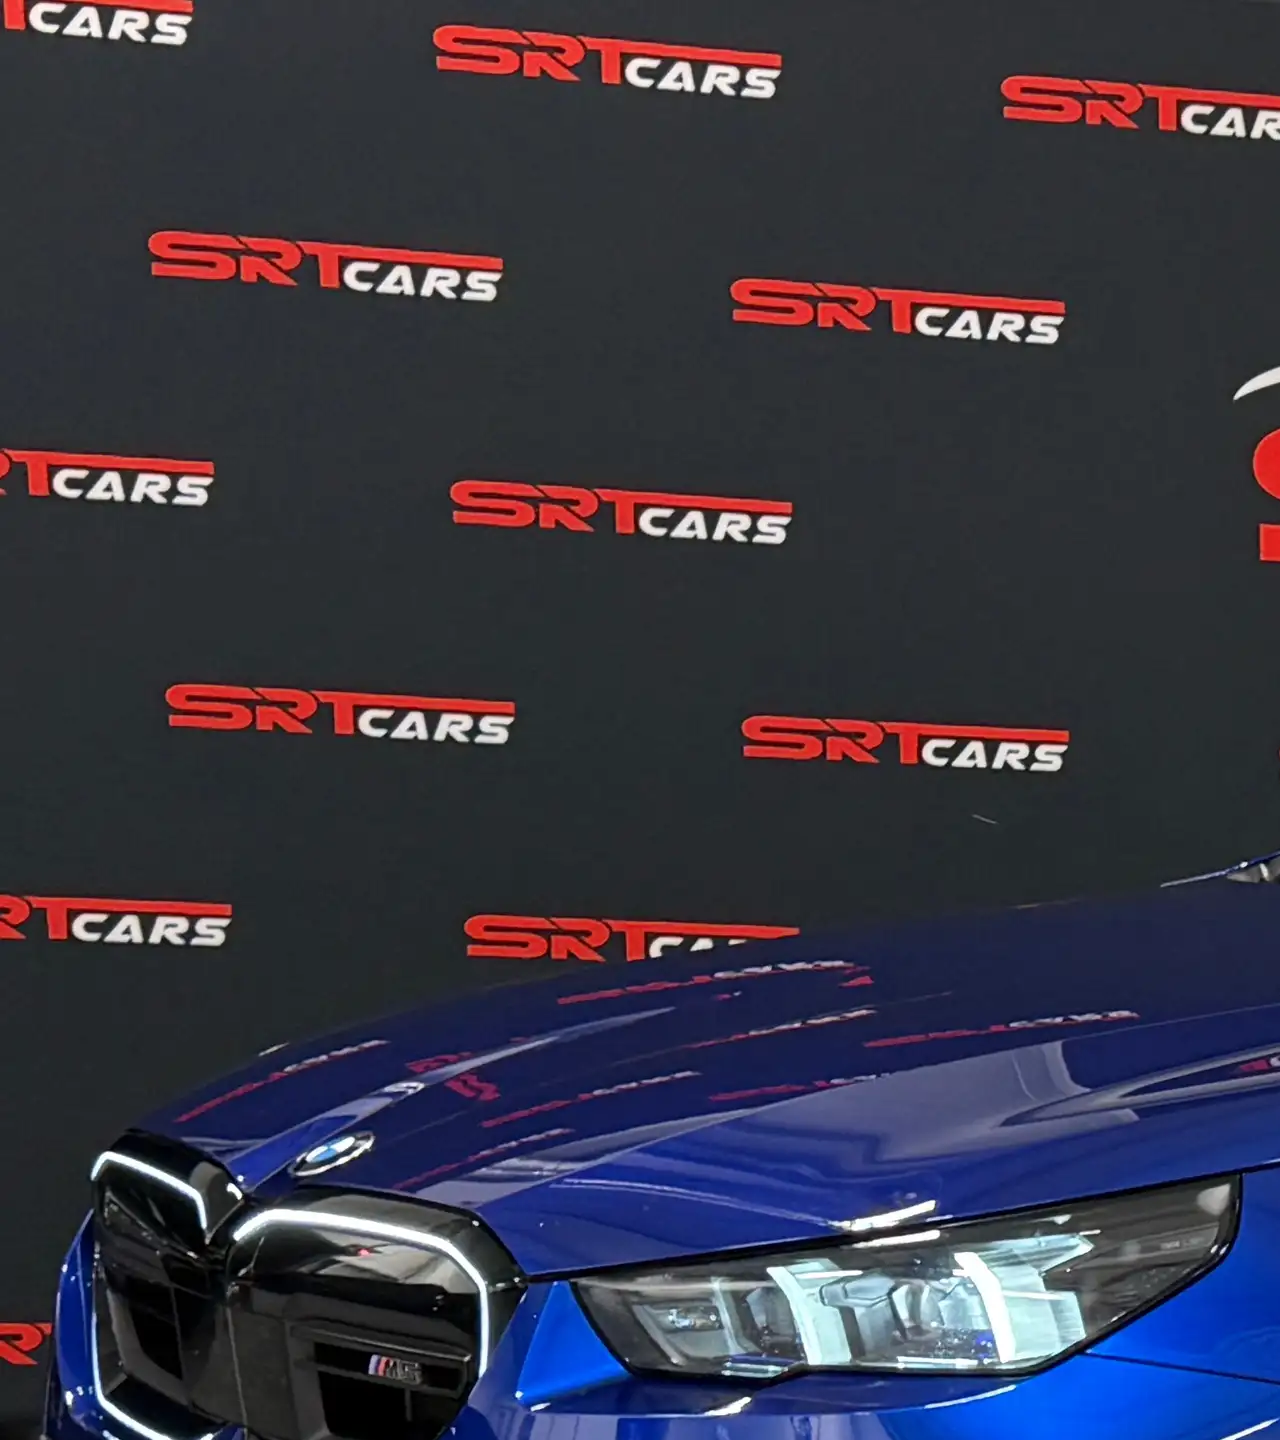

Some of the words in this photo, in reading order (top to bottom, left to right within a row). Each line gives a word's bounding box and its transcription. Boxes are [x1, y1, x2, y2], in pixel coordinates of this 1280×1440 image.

[29, 3, 192, 45] CARS
[625, 58, 780, 98] CARS
[344, 262, 501, 301] CARS
[916, 308, 1064, 343] CARS
[53, 469, 213, 505] CARS
[639, 508, 791, 544] CARS
[359, 710, 513, 743] CARS
[922, 740, 1067, 771] CARS
[72, 914, 230, 945] CARS
